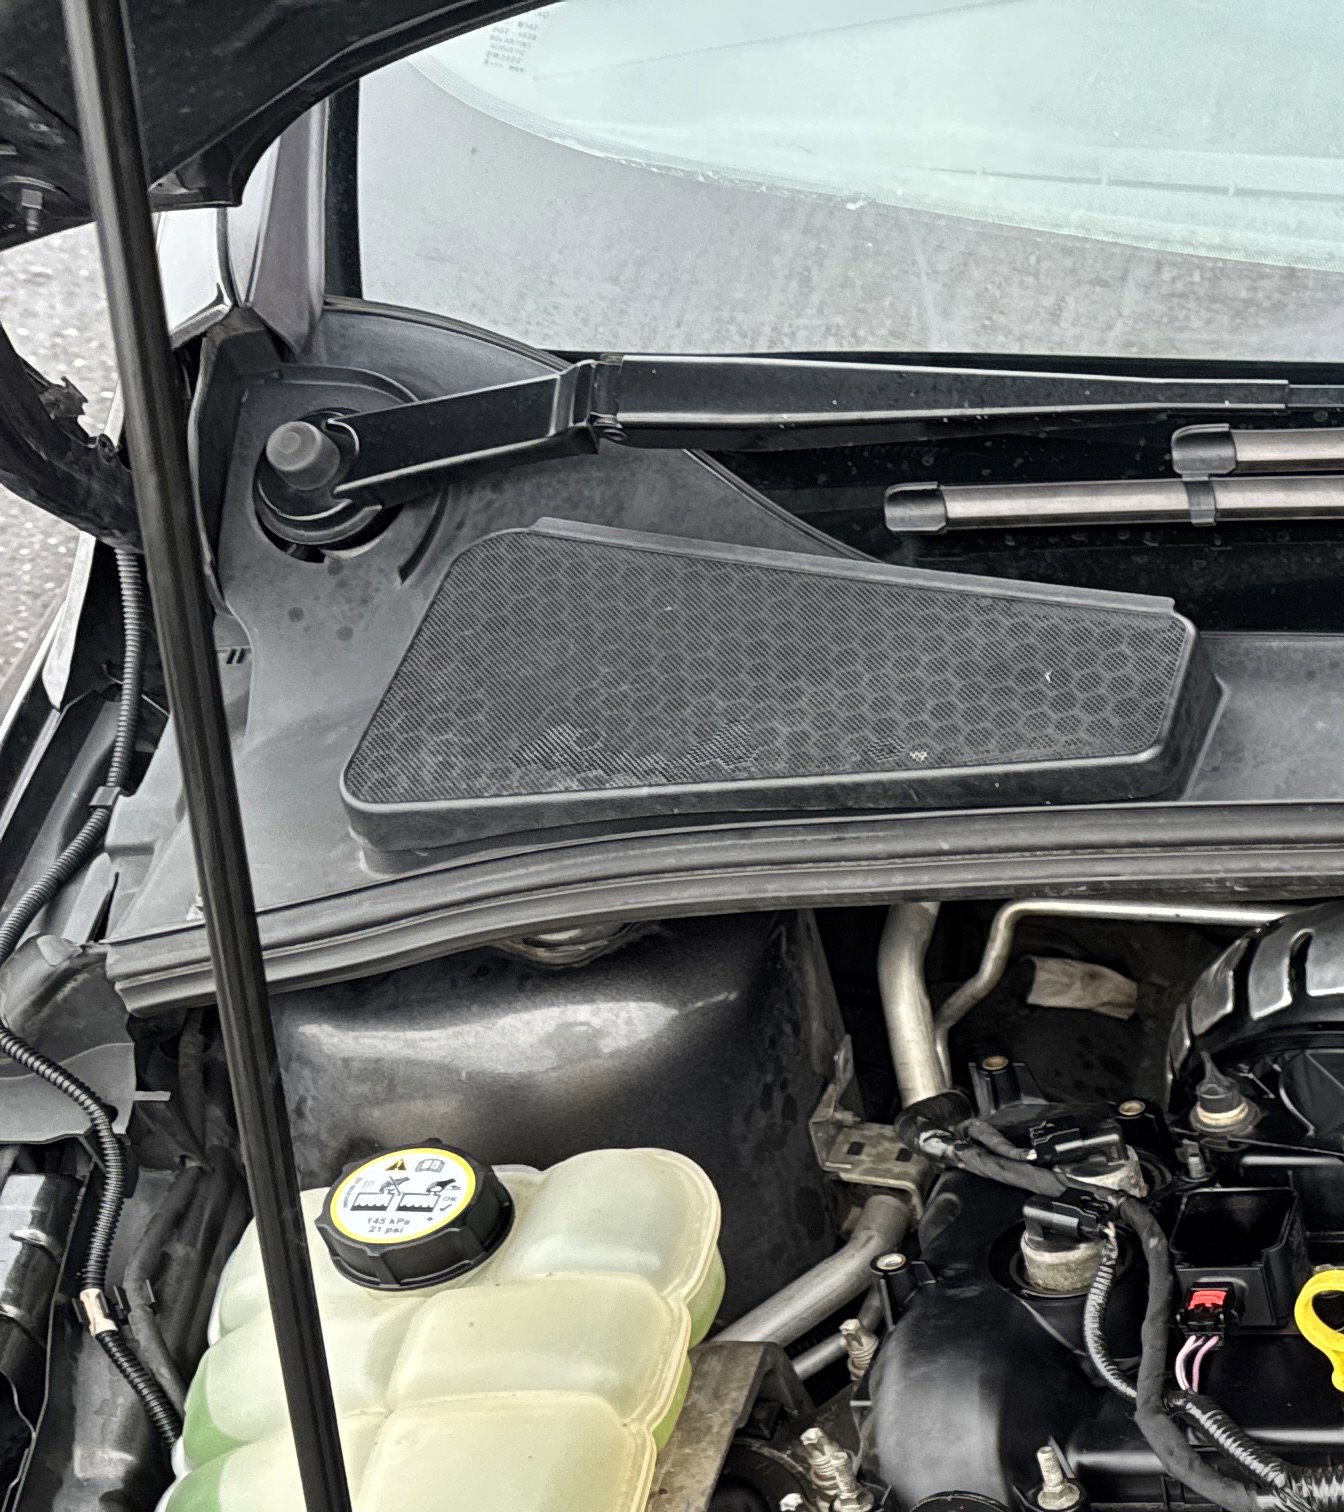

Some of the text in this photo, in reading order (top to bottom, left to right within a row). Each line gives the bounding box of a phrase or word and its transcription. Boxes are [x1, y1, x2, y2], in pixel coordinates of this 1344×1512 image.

[367, 1217, 411, 1226] 145 kPa
[385, 1226, 404, 1234] psi
